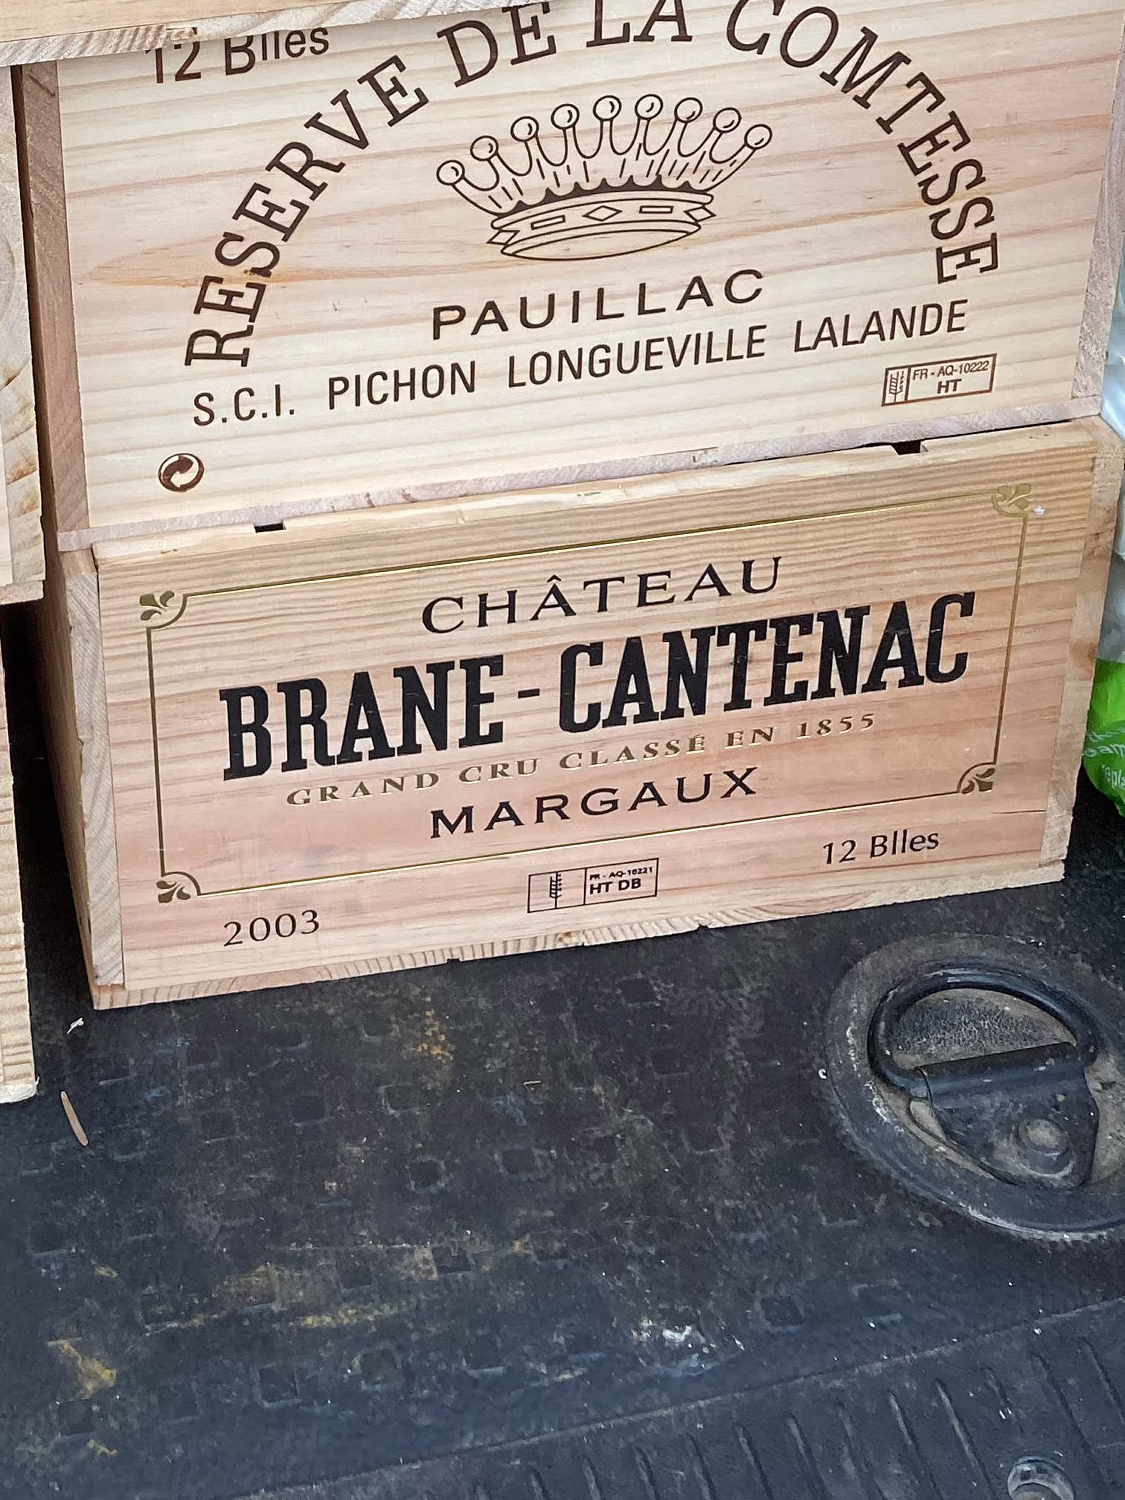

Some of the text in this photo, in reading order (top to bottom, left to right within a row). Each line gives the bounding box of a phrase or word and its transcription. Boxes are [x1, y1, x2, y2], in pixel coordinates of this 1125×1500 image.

[145, 27, 202, 84] 12
[184, 55, 430, 368] RESERVE
[436, 0, 557, 88] DE
[432, 268, 764, 341] PAUILLAC
[193, 298, 968, 427] S.C.I. PICHON LONGUEVILLE LALANDE
[936, 378, 962, 395] HT
[422, 556, 783, 634] CHÂTEAU
[286, 713, 875, 806] GRAND CRU CLASSÉ EN 1855
[430, 767, 759, 840] MARGAUX
[589, 878, 642, 895] HT DB
[822, 838, 856, 866] 12
[223, 908, 321, 947] 2003
